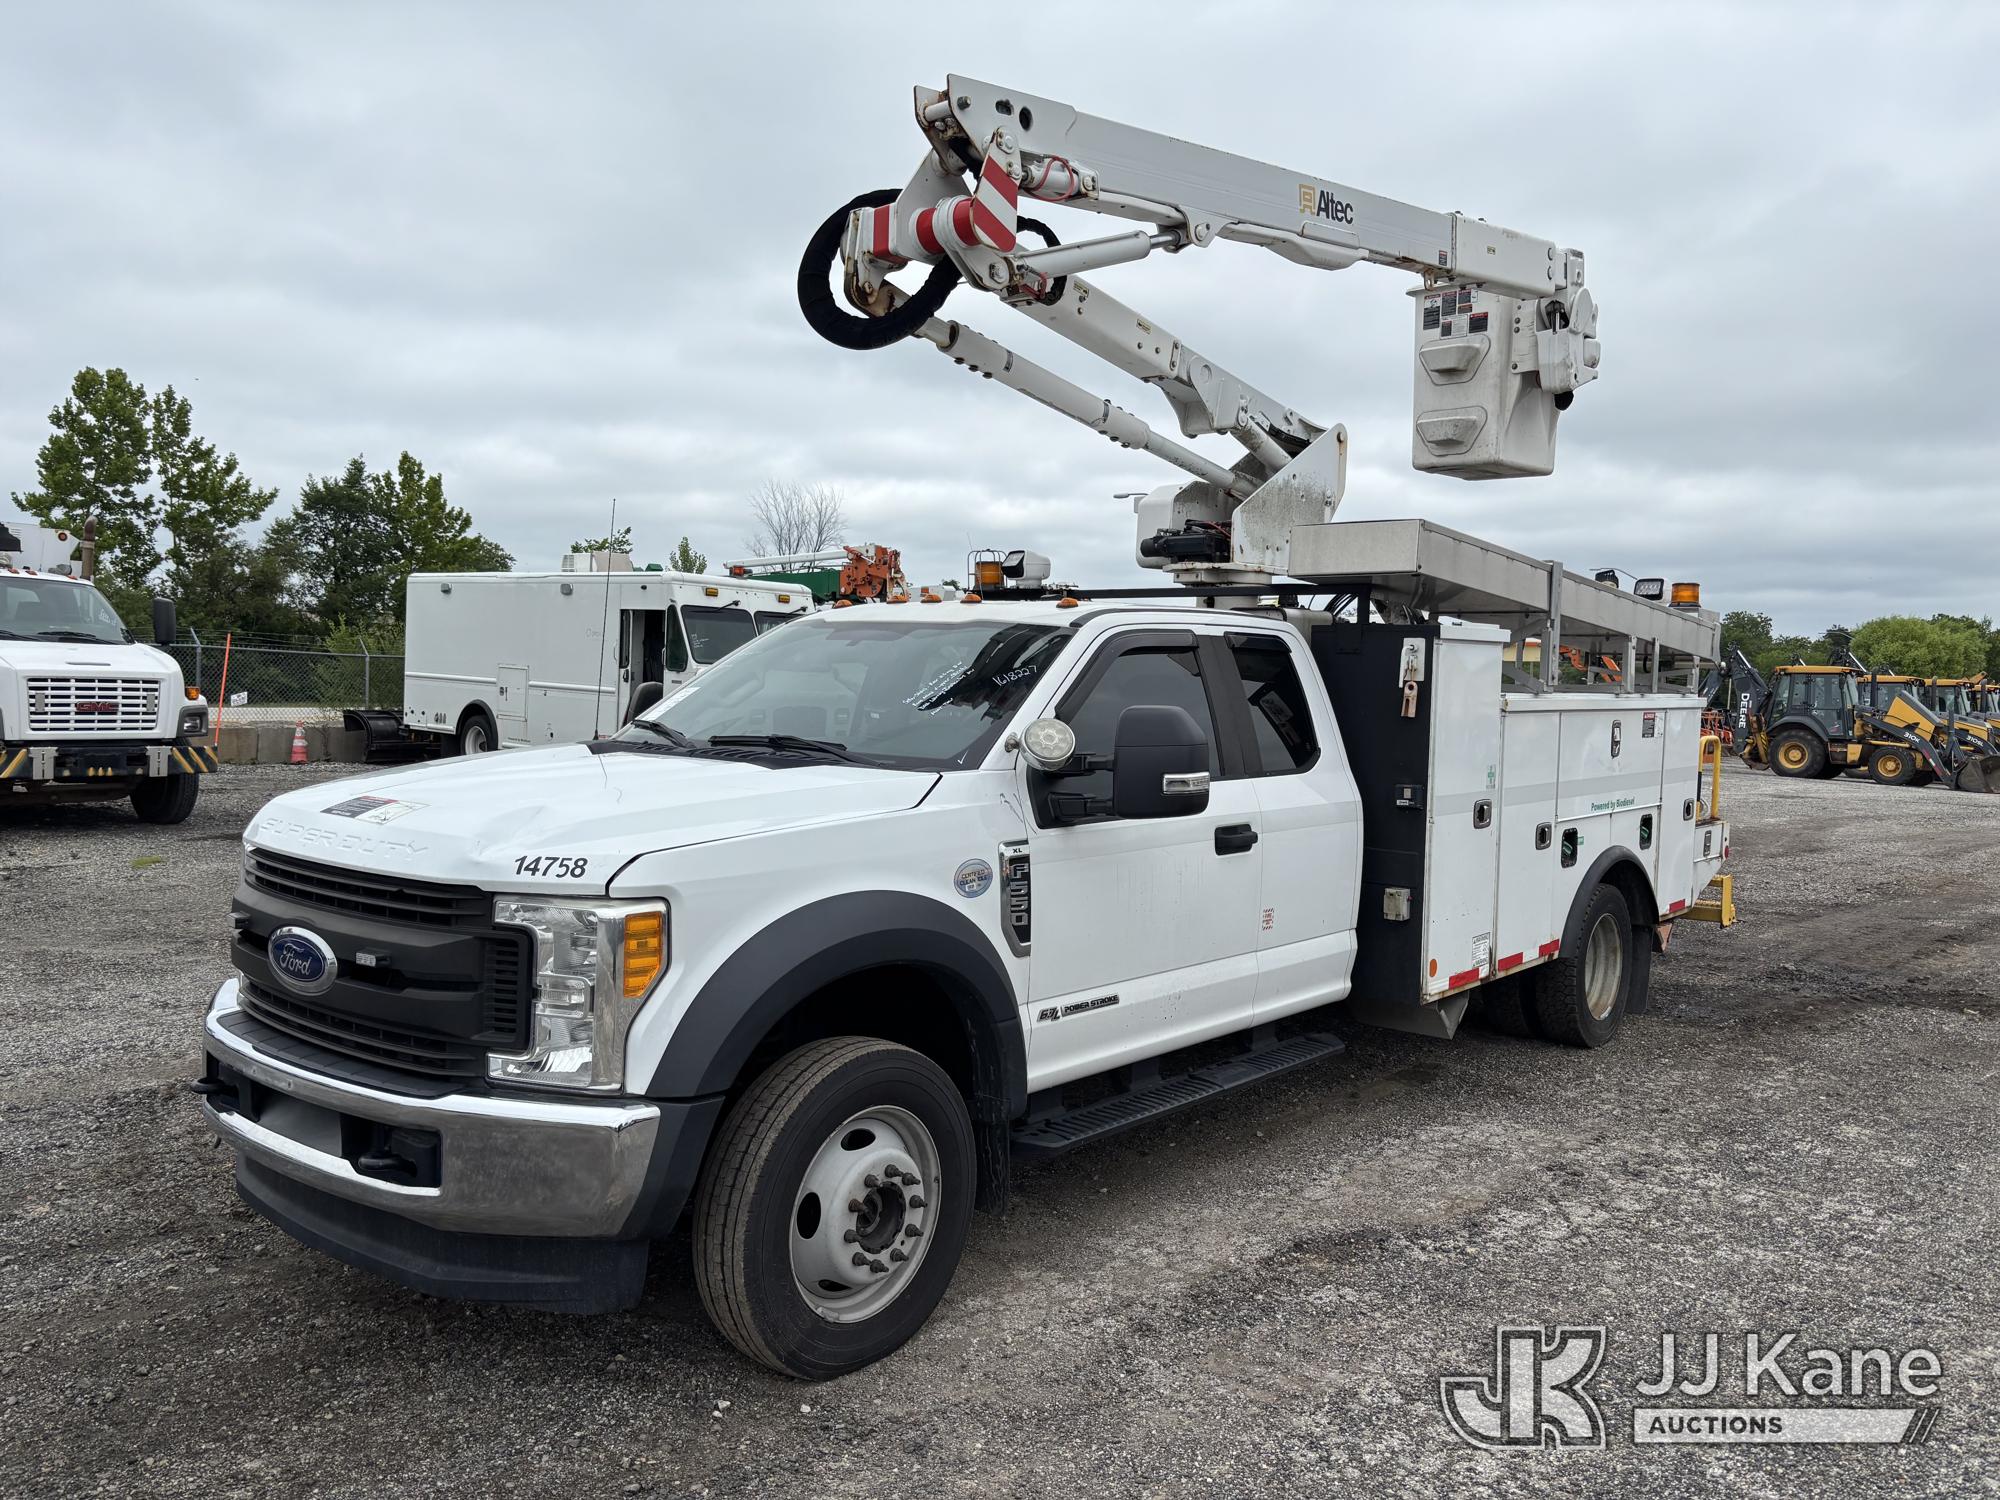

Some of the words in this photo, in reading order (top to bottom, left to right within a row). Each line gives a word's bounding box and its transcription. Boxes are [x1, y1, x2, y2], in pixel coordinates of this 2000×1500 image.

[1316, 189, 1354, 225] Altec
[992, 665, 1038, 687] 1618227
[76, 701, 120, 713] GMC
[1739, 693, 1750, 729] DEERE
[1904, 732, 1920, 744] 310K
[1591, 801, 1610, 811] Powered
[1616, 797, 1635, 807] Biodiesel
[260, 818, 337, 847] SUPER
[342, 834, 429, 861] DUTY
[514, 855, 589, 879] 14758
[959, 878, 976, 886] CLEAN
[280, 943, 312, 975] Ford
[1064, 1001, 1090, 1013] POWER
[1090, 994, 1118, 1007] STROKE
